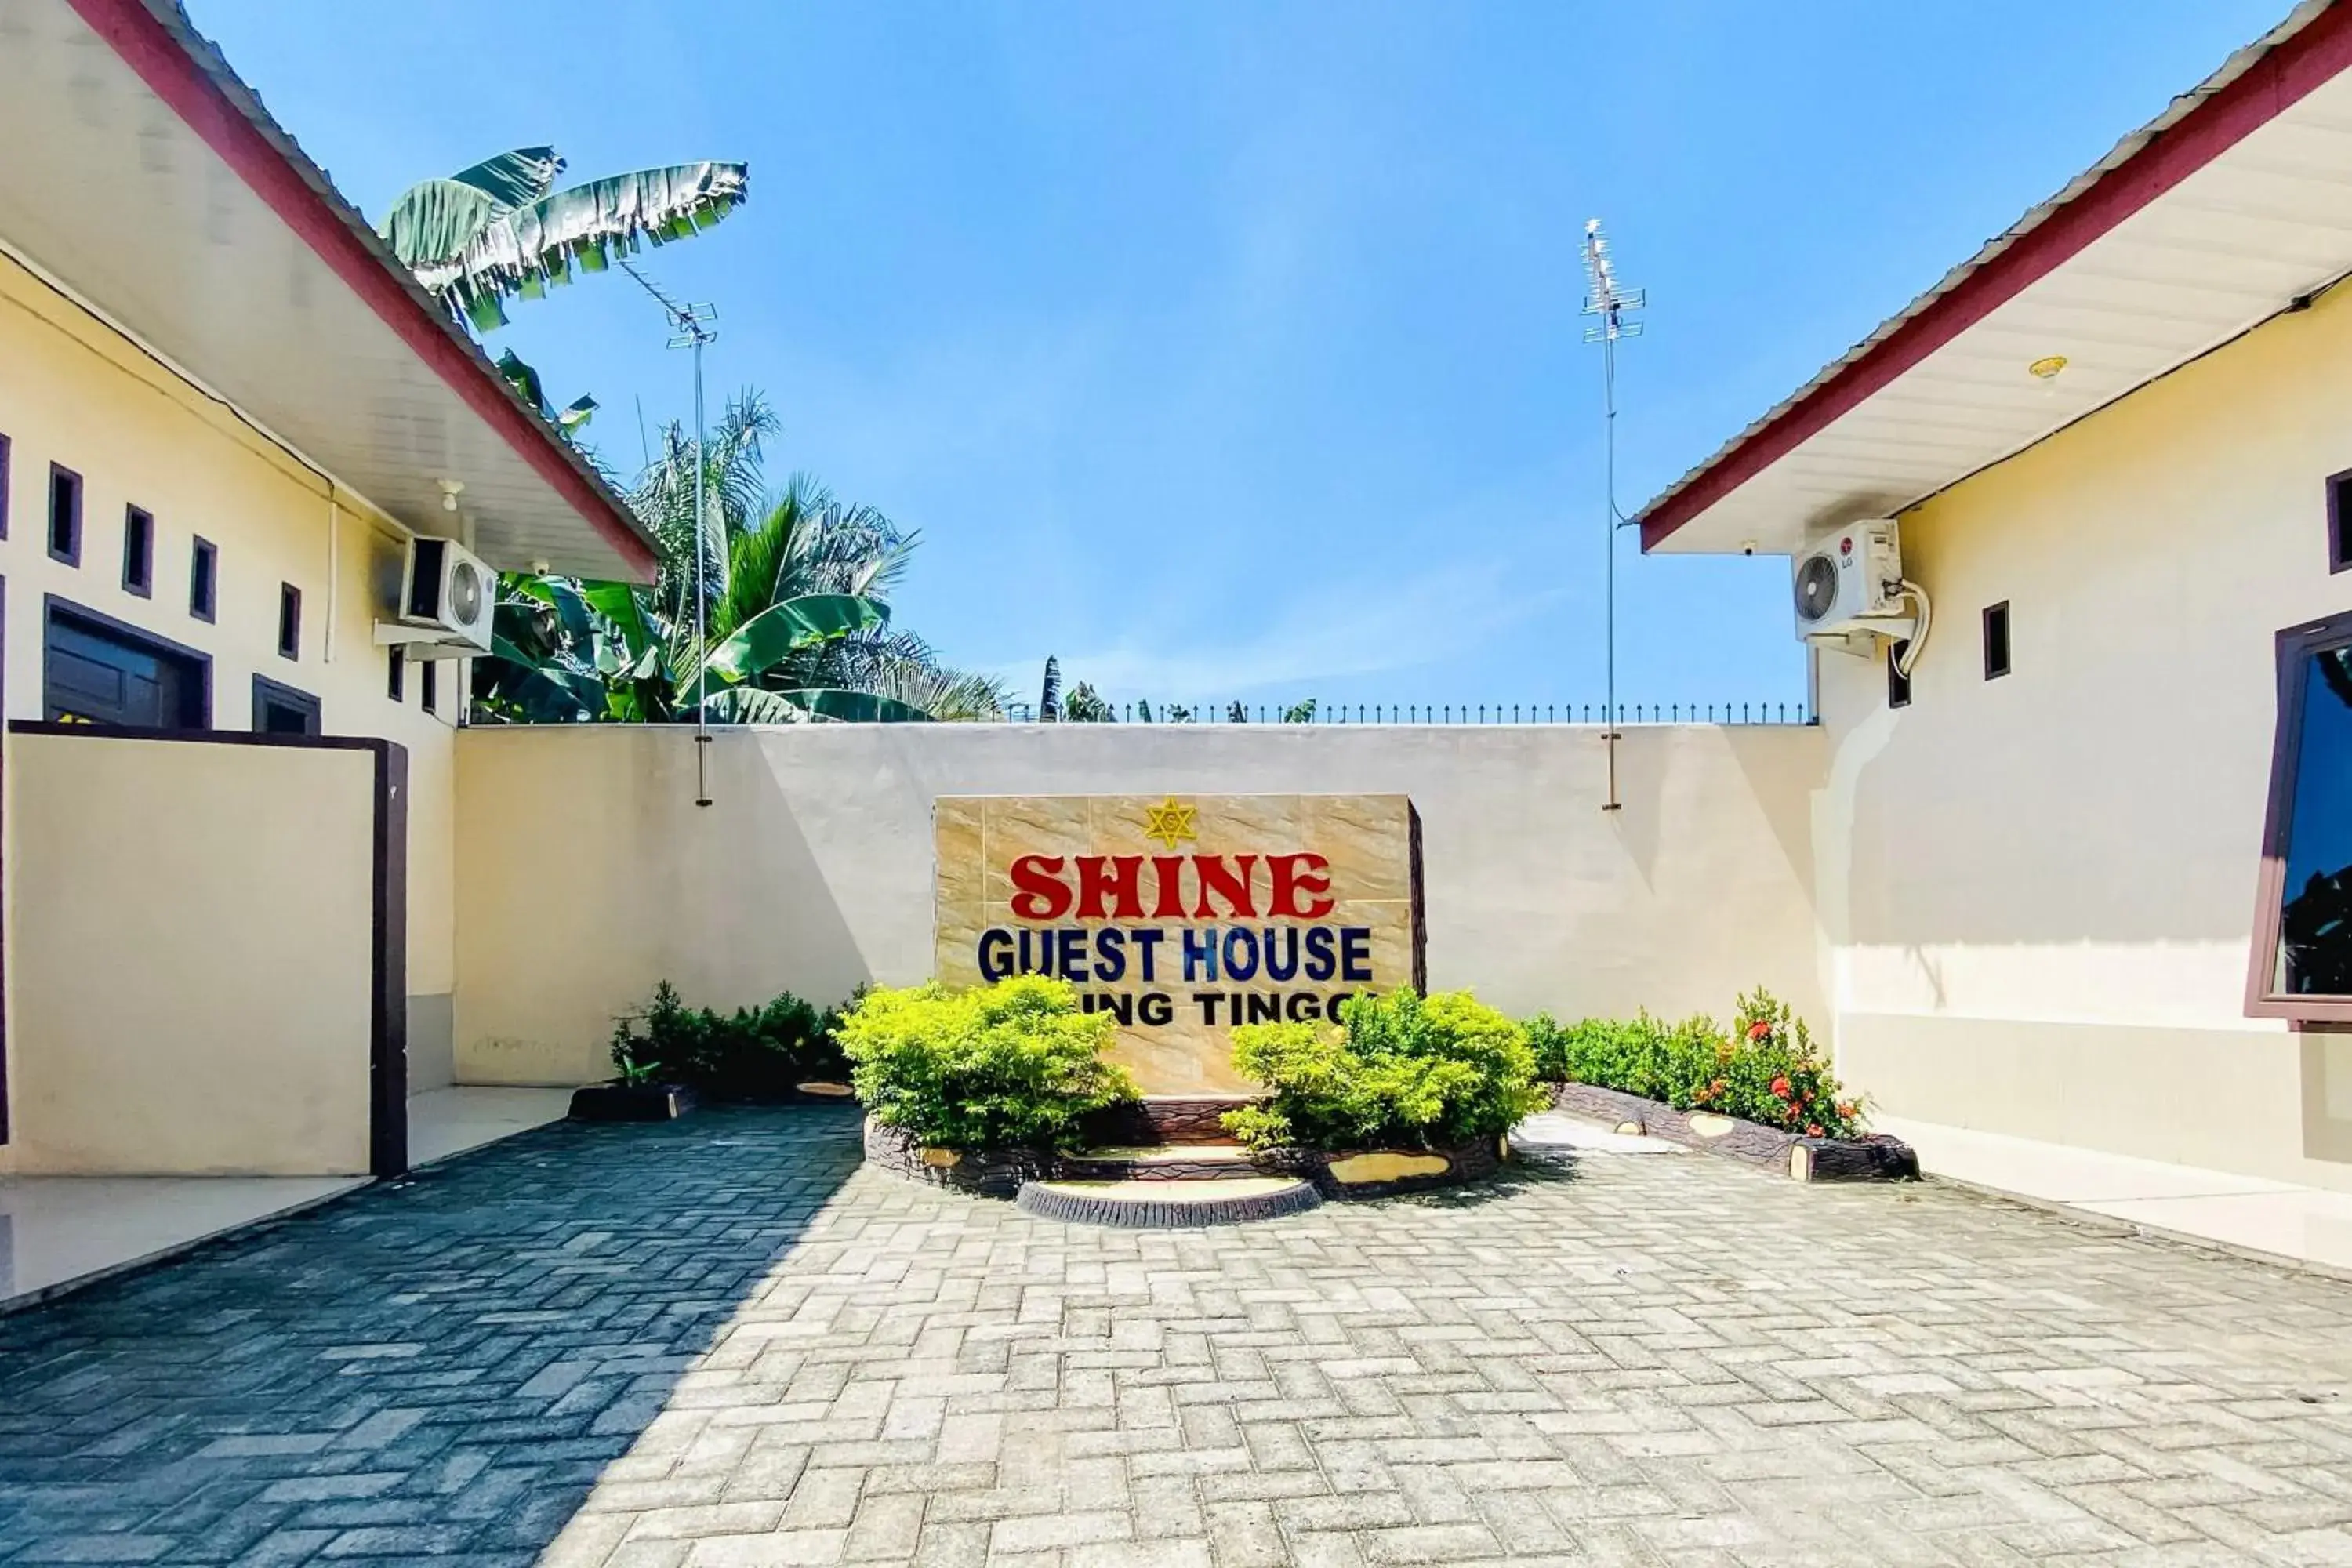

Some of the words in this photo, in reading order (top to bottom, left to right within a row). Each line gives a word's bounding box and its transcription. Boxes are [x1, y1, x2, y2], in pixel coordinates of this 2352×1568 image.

[1011, 854, 1334, 919] SHINE
[978, 927, 1164, 982] GUEST
[1183, 927, 1373, 982] HOUSE
[1192, 993, 1377, 1025] TING
